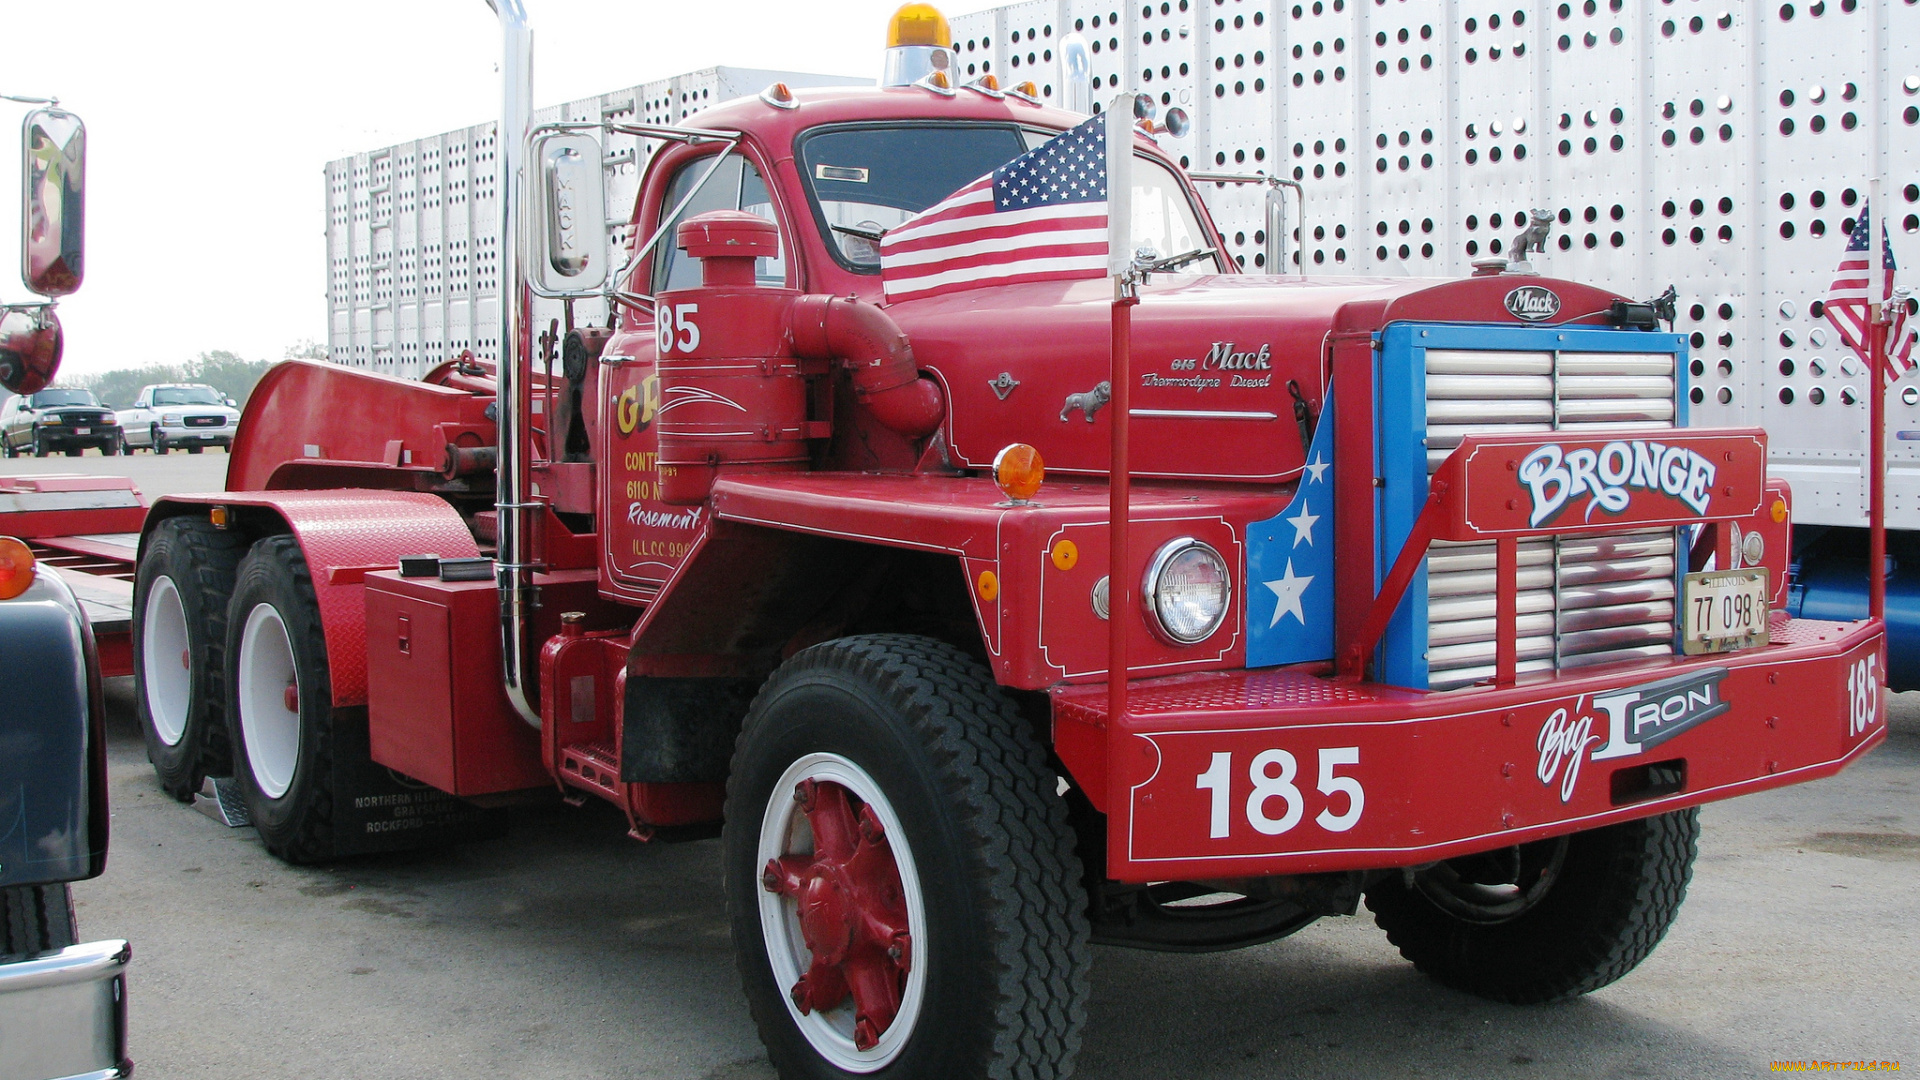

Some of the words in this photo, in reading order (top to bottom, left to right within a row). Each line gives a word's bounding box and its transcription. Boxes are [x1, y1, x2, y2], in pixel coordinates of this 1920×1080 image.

[558, 180, 574, 250] MACK
[1511, 290, 1555, 313] Mack
[1202, 341, 1271, 371] Mack
[1229, 373, 1271, 387] Diesel
[626, 480, 649, 500] 6110
[1518, 440, 1717, 529] BRONGE
[1708, 577, 1746, 589] ILLINOIS
[1694, 596, 1713, 632] 77
[1723, 593, 1751, 629] 098
[1847, 653, 1877, 737] 185
[1536, 694, 1601, 803] Big
[1591, 684, 1712, 761] IRON
[355, 794, 411, 808] NORTHERN
[1195, 746, 1366, 839] 185
[366, 819, 423, 833] ROCKFORD
